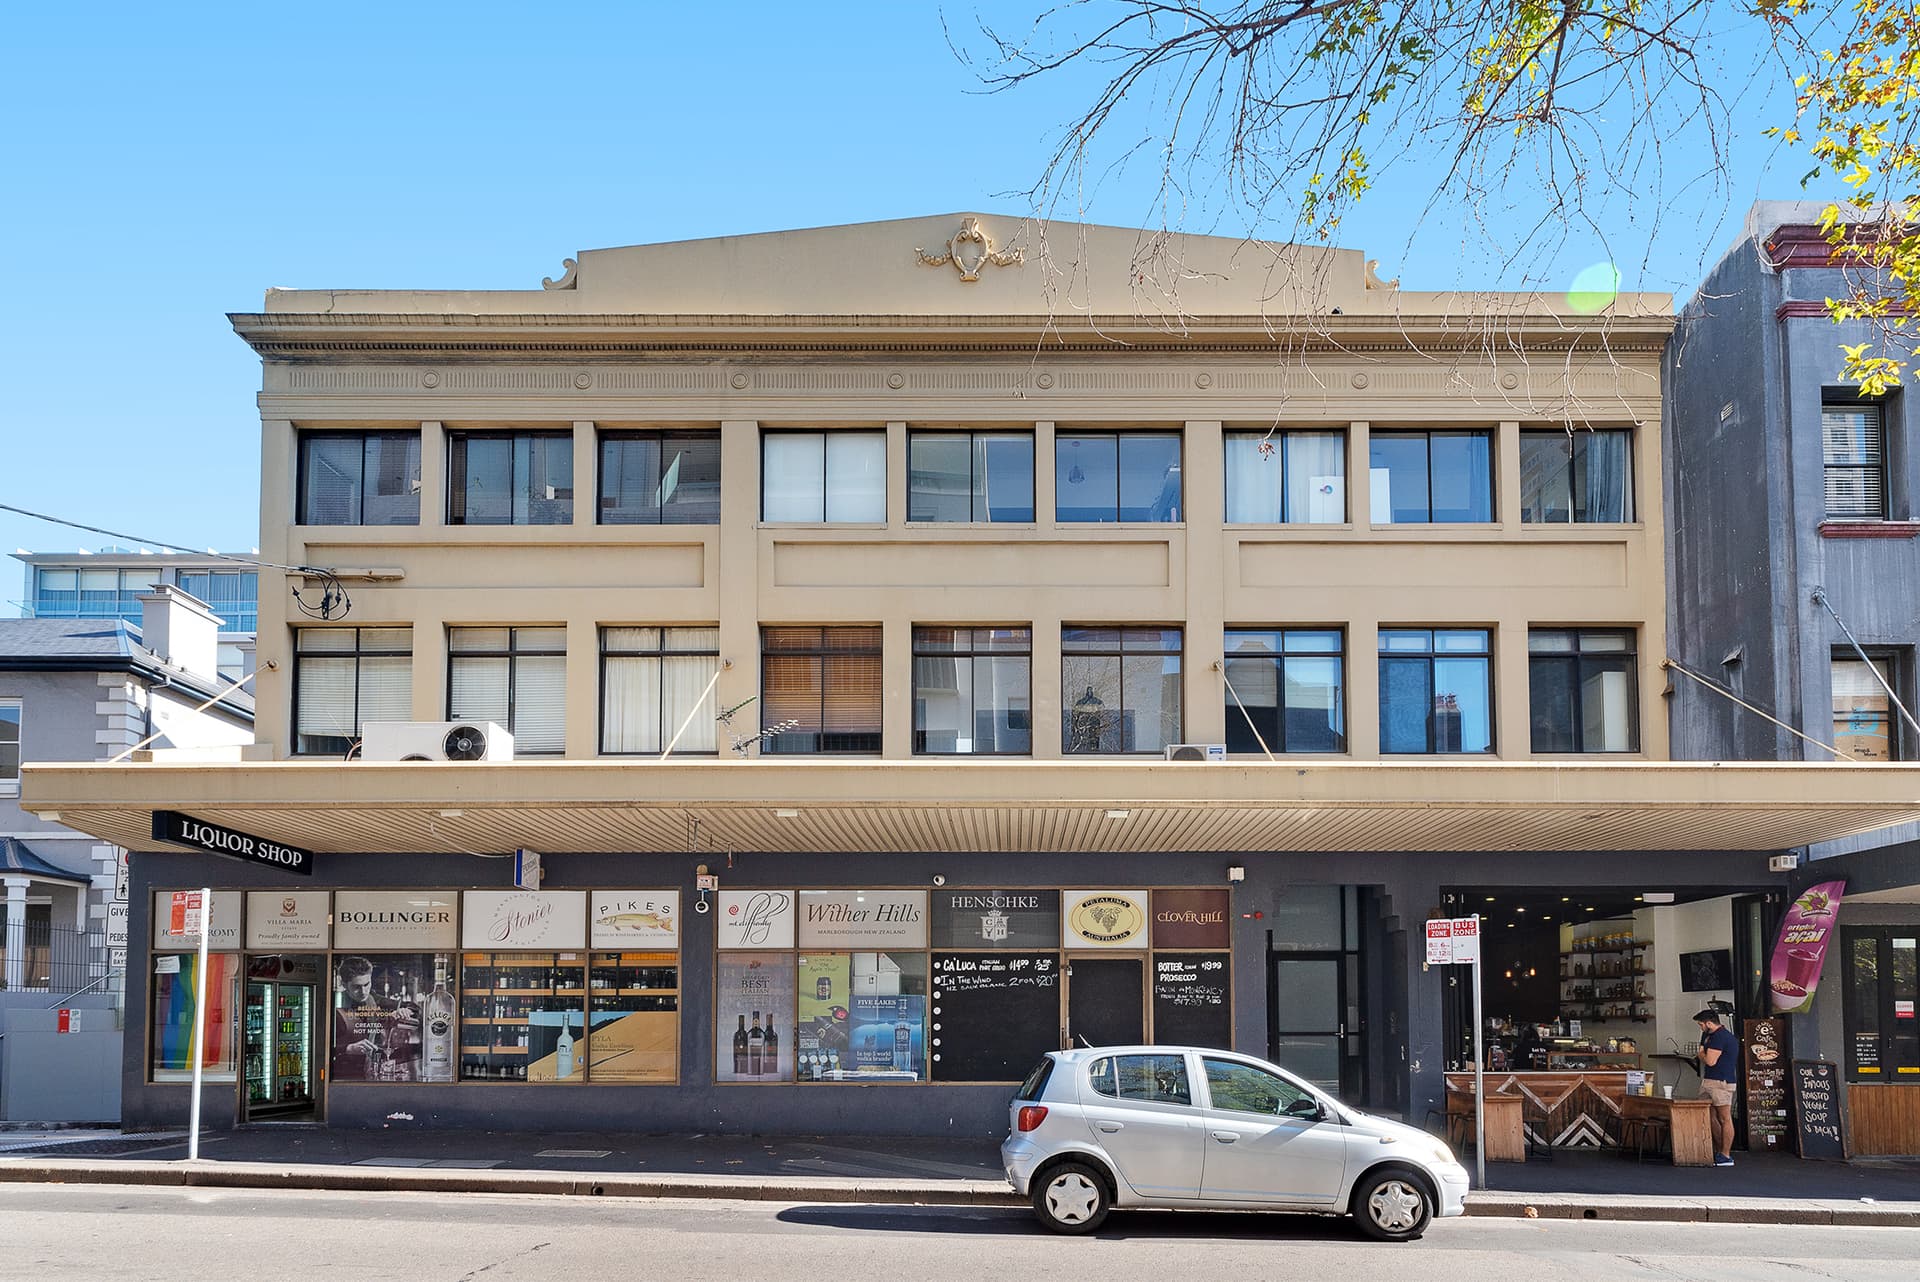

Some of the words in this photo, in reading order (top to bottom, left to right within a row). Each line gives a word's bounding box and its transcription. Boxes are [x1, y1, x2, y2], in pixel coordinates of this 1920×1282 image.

[182, 820, 254, 855] LIQUOR
[257, 842, 302, 866] SHOP
[600, 901, 671, 914] PIKES
[951, 896, 1039, 908] HENSCHKE
[340, 912, 449, 923] BOLLINGER
[807, 903, 870, 922] Wither
[874, 903, 921, 922] Hills
[1157, 911, 1206, 925] CLOVER
[1200, 911, 1223, 923] HILL
[488, 902, 553, 941] Stonier
[1160, 973, 1197, 982] PROSECCO
[741, 980, 770, 989] BEST
[1805, 1110, 1827, 1123] SOUP
